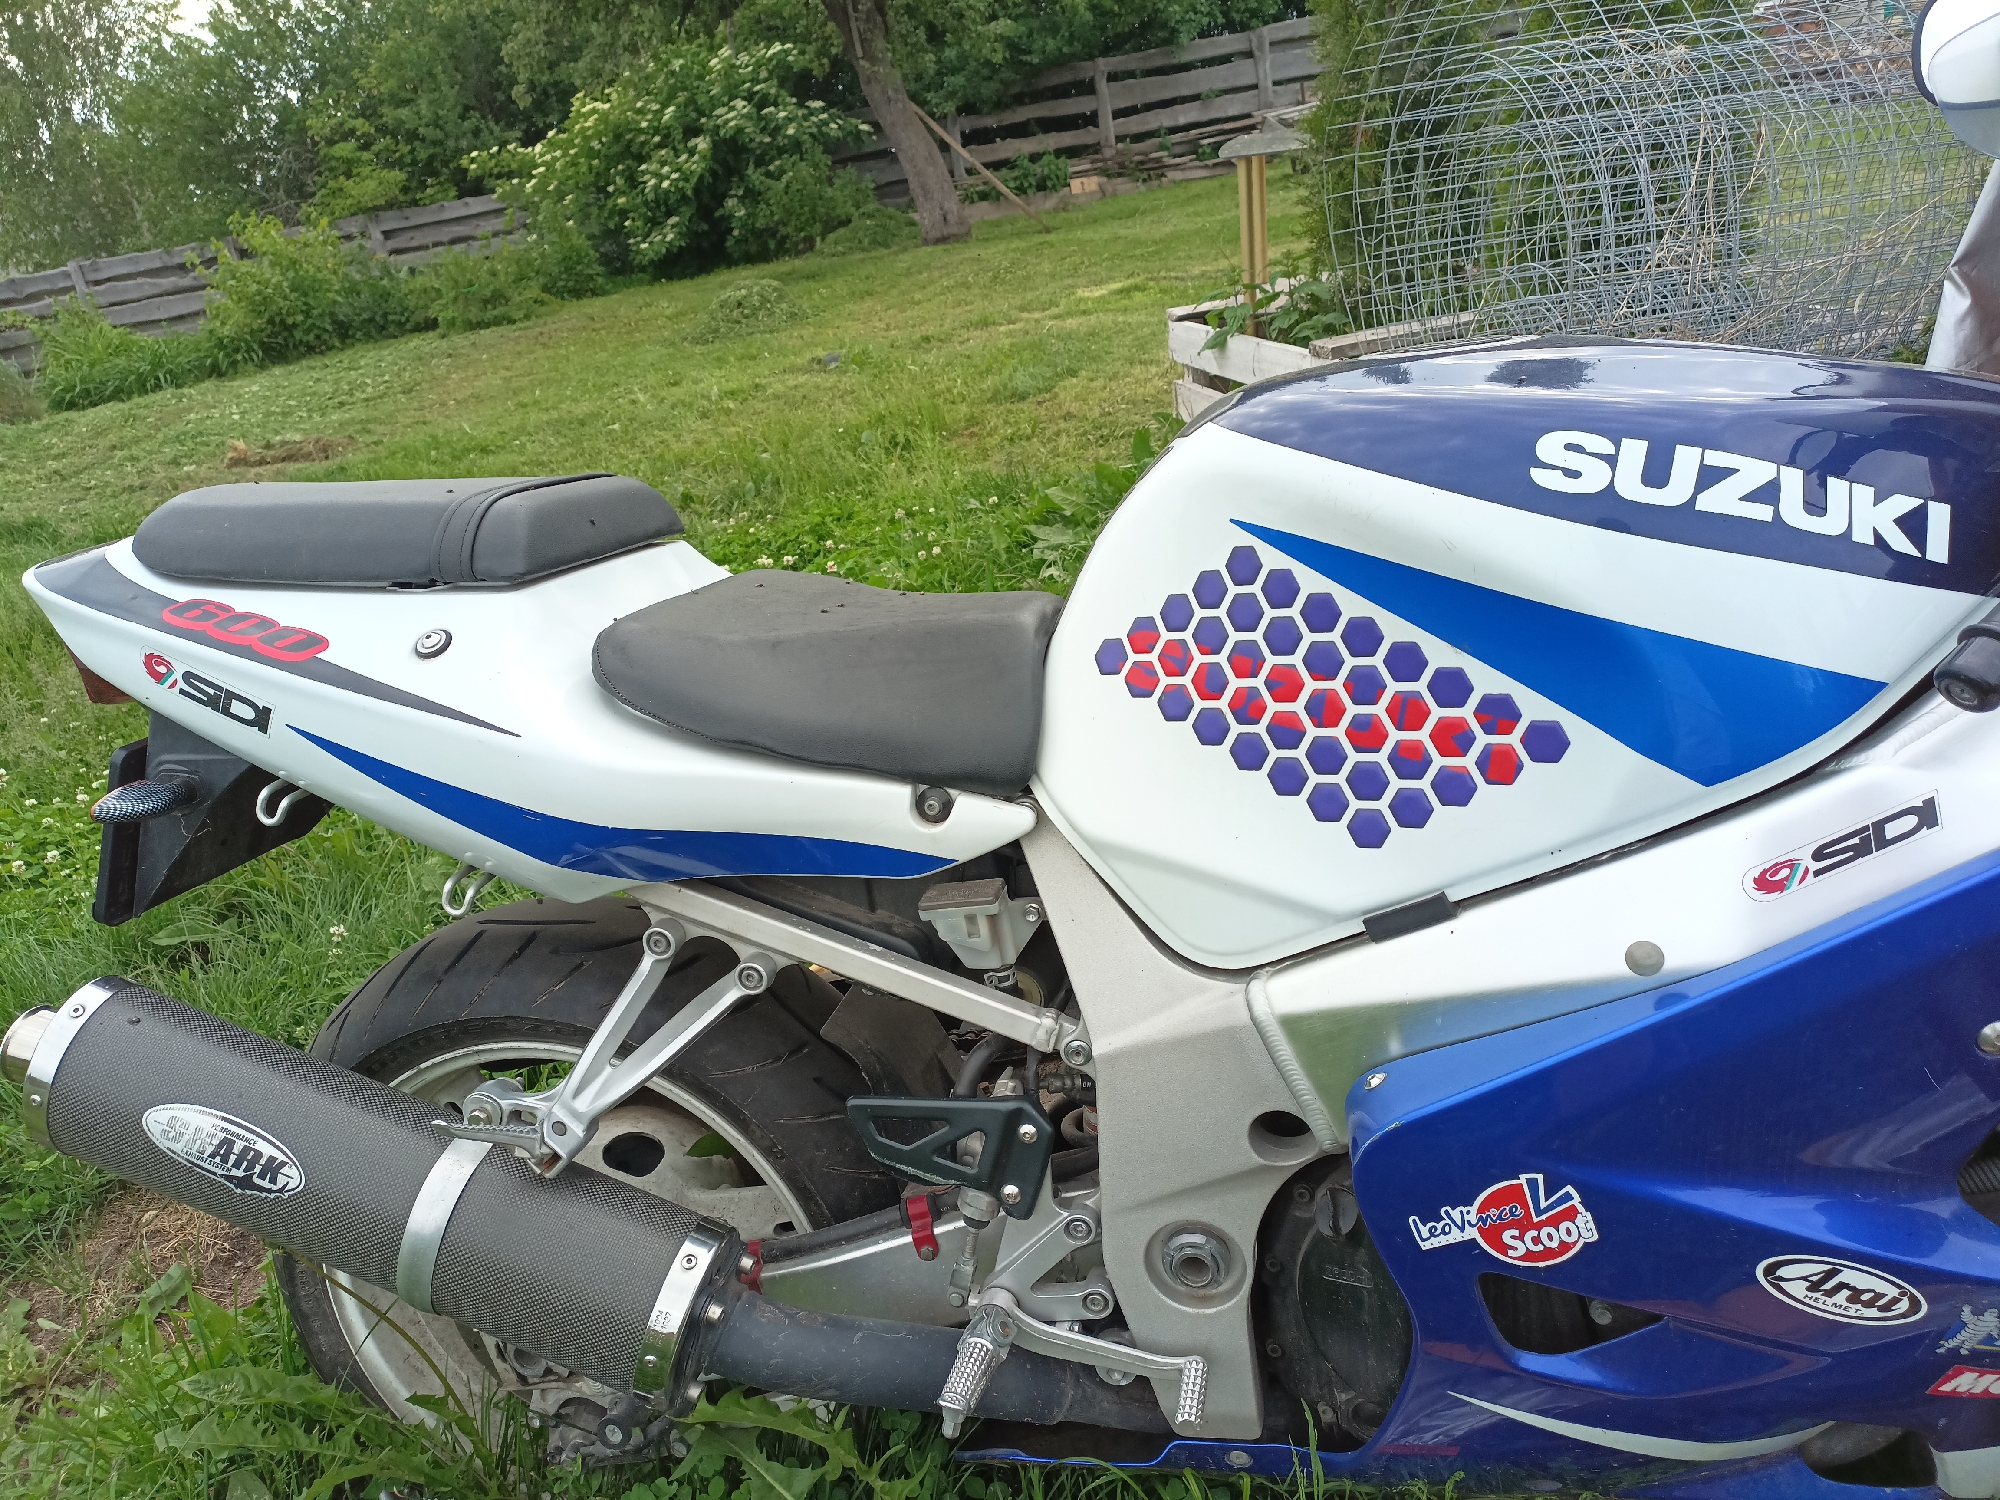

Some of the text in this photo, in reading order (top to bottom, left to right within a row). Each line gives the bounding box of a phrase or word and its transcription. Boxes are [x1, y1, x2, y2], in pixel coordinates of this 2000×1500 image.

[1529, 430, 1951, 564] SUZUKI
[162, 598, 329, 662] 600
[179, 670, 273, 735] SIDI
[1811, 796, 1939, 878] SIDI
[206, 1158, 233, 1174] SYSTEM
[1411, 1204, 1524, 1243] LeoVince
[1502, 1212, 1596, 1258] Scoot
[1768, 1266, 1910, 1314] Arai
